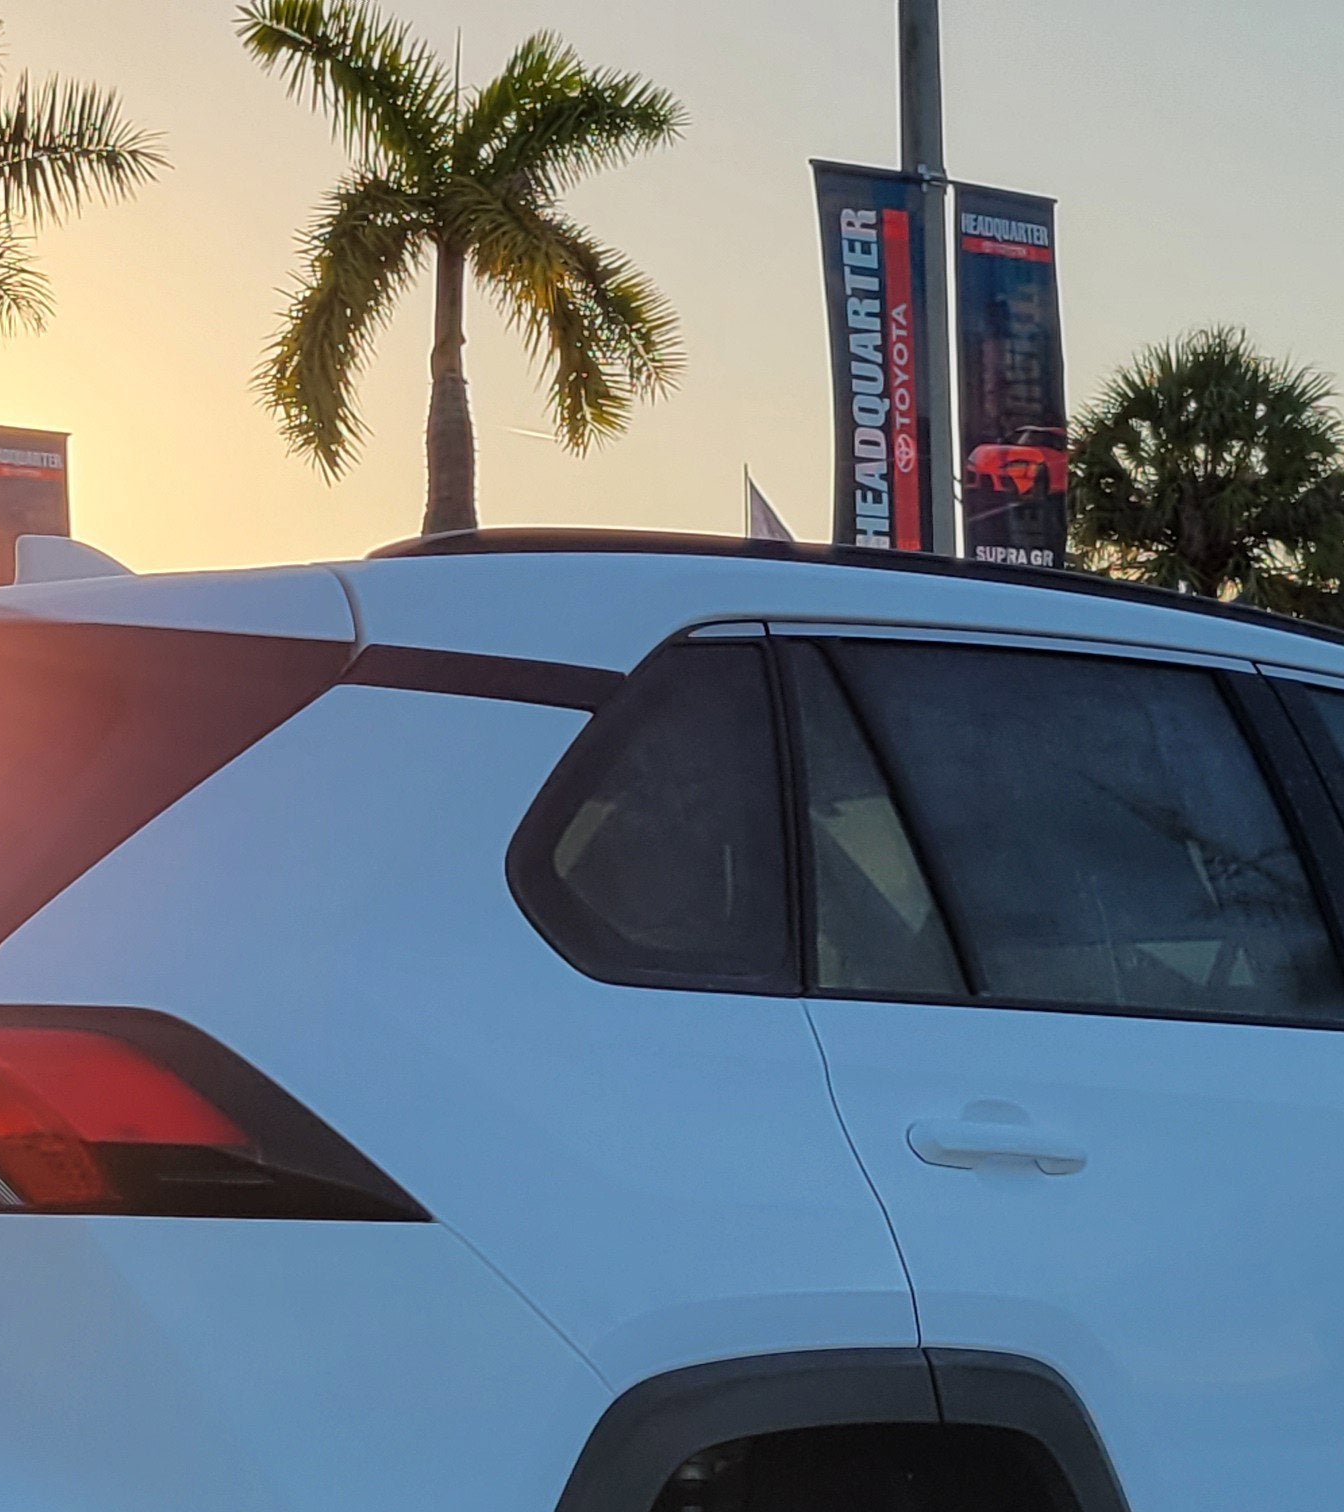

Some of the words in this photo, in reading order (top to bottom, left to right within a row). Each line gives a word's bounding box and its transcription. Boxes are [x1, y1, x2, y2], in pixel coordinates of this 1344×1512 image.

[961, 213, 1048, 247] HEADQUARTER
[840, 208, 892, 549] HEADQUARTER
[888, 303, 910, 428] TOYOTA
[976, 545, 1028, 565] SUPRA
[1030, 549, 1054, 567] GR
